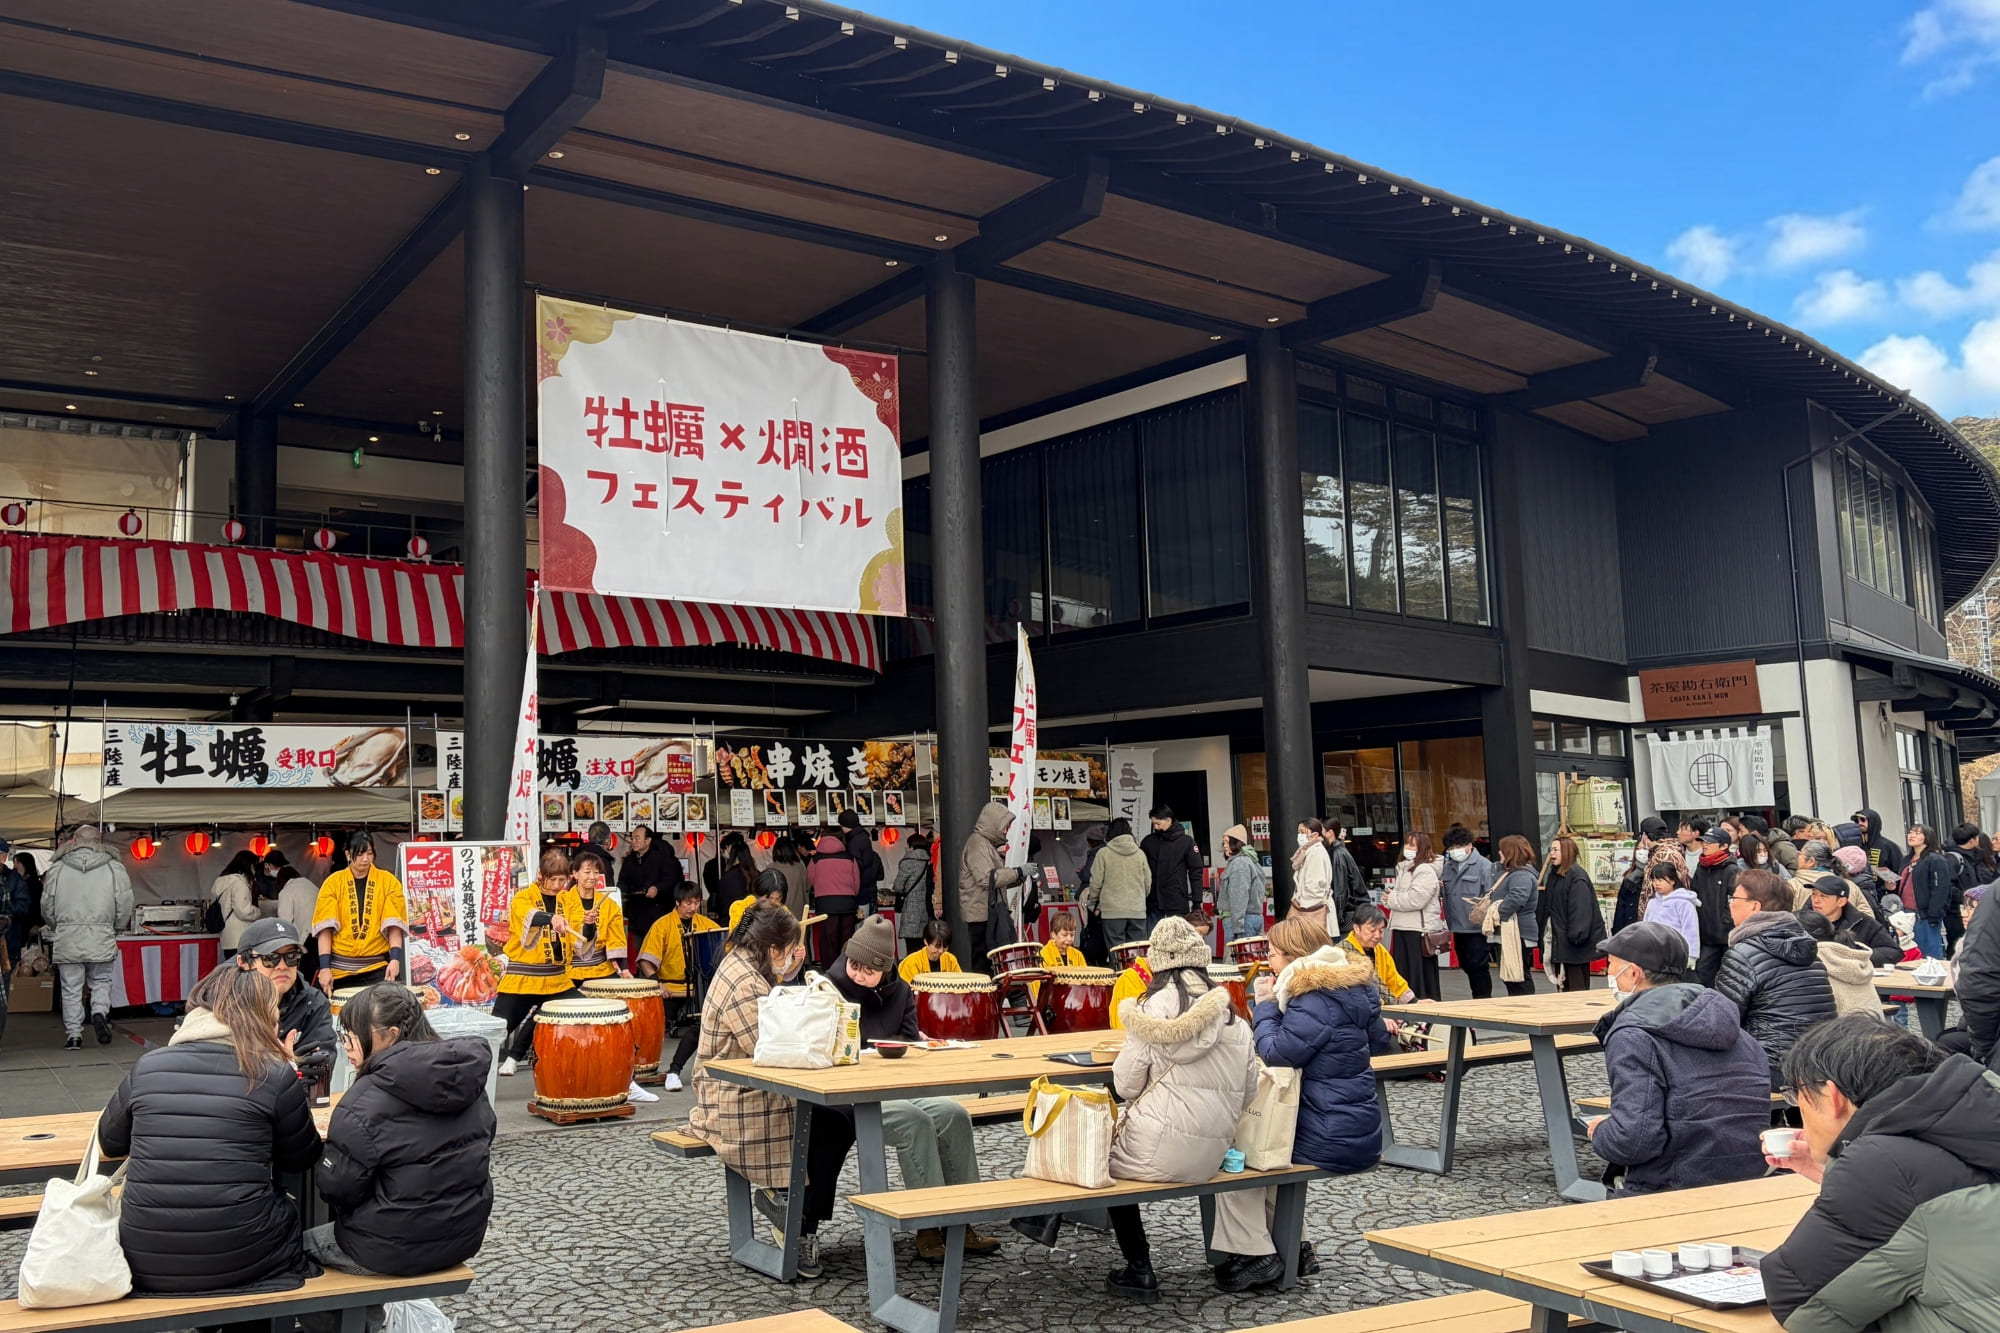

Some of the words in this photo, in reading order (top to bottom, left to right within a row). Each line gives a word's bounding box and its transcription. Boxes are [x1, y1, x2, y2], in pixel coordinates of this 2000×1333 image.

[586, 469, 873, 528] フェスティバル
[1649, 675, 1748, 694] 茶屋勘右衛門
[1693, 693, 1706, 701] KAN
[104, 729, 124, 787] 三陸産
[140, 726, 269, 785] 牡蠣
[276, 747, 337, 770] 受取口
[446, 737, 462, 789] 三陸産
[537, 738, 581, 790] 蠣
[585, 757, 636, 777] 注文口
[766, 741, 870, 788] 串焼き
